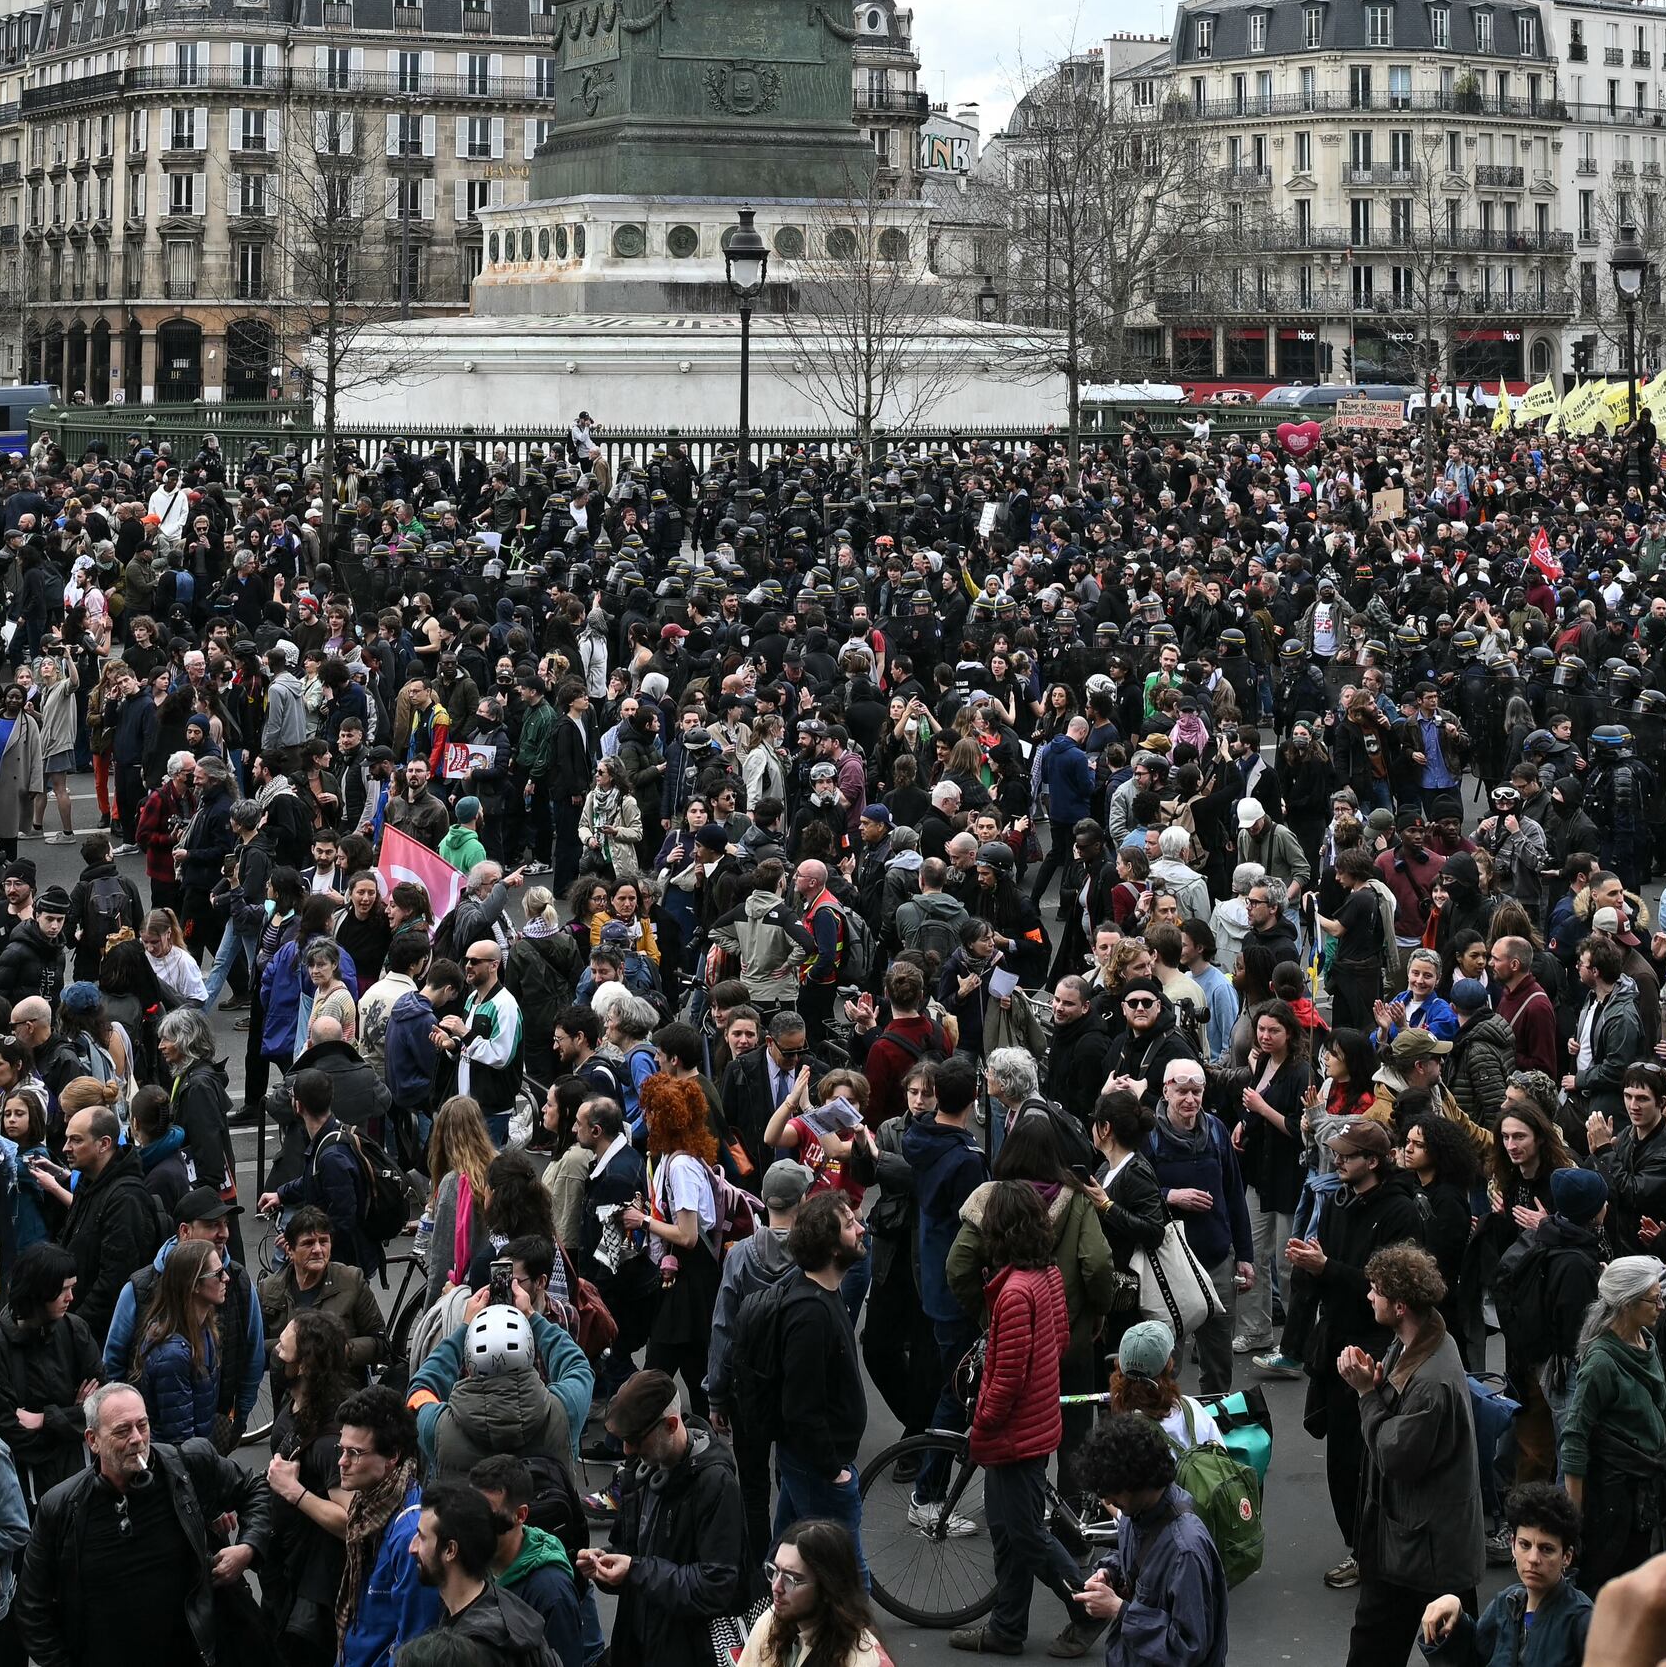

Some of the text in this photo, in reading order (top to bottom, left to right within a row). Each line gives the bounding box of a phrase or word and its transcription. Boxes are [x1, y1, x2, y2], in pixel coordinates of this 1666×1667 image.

[1503, 330, 1521, 342] hippo
[1532, 396, 1554, 408] Droits
[1316, 619, 1333, 630] 75
